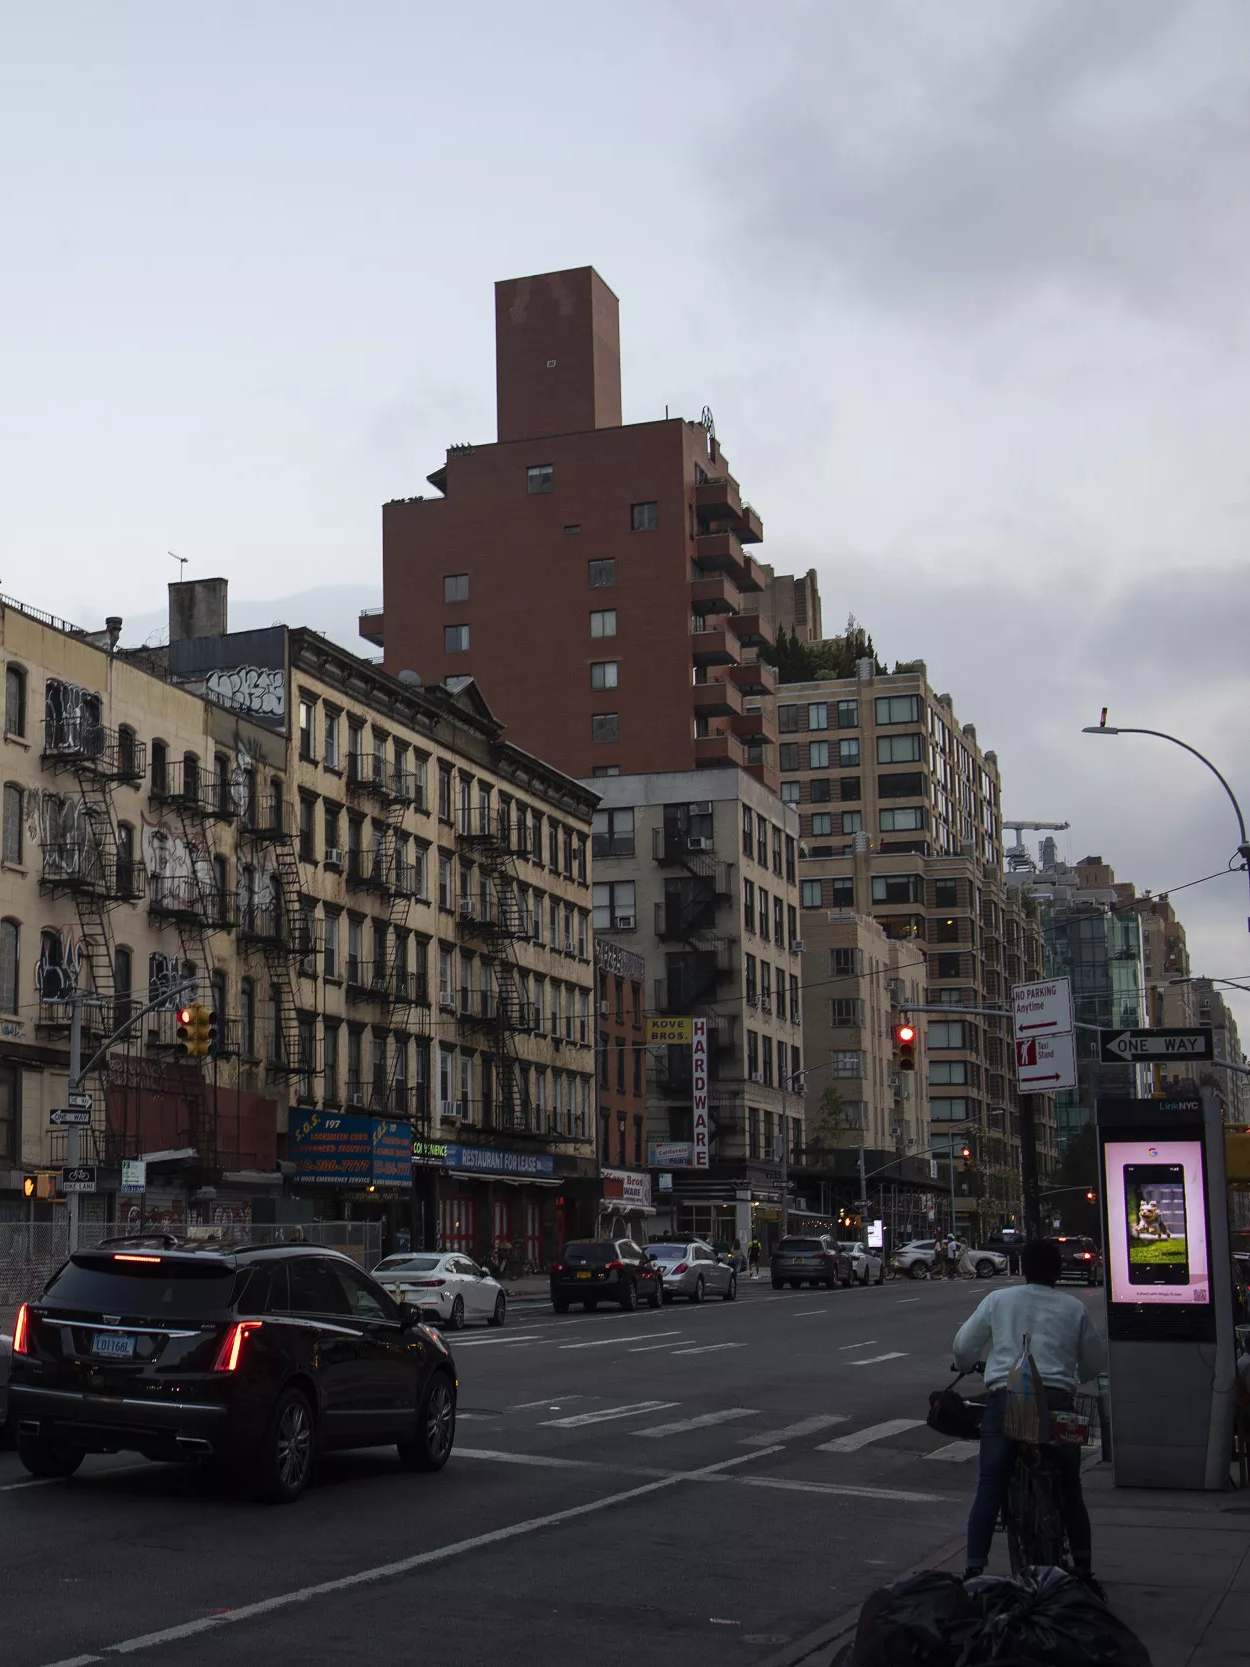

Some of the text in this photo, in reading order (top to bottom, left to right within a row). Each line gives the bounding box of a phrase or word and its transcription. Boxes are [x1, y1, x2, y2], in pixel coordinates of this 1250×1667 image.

[1015, 985, 1057, 1000] NO PARKING
[1016, 1001, 1044, 1014] Anytime
[652, 1020, 684, 1028] KOVE
[651, 1032, 688, 1040] BROS.
[1037, 1042, 1049, 1050] Taxi
[1117, 1038, 1198, 1052] ONE WAY
[1038, 1050, 1054, 1060] Stand
[693, 1021, 707, 1166] HARDWARE
[1159, 1101, 1198, 1110] LinkNYC
[74, 1113, 87, 1121] WAY
[325, 1120, 341, 1129] 197
[337, 1145, 371, 1153] SECURITY
[462, 1148, 503, 1169] RESTAURANT
[504, 1153, 517, 1170] FOR
[518, 1155, 537, 1172] LEASE
[627, 1175, 643, 1186] Bros
[79, 1183, 95, 1191] LANE
